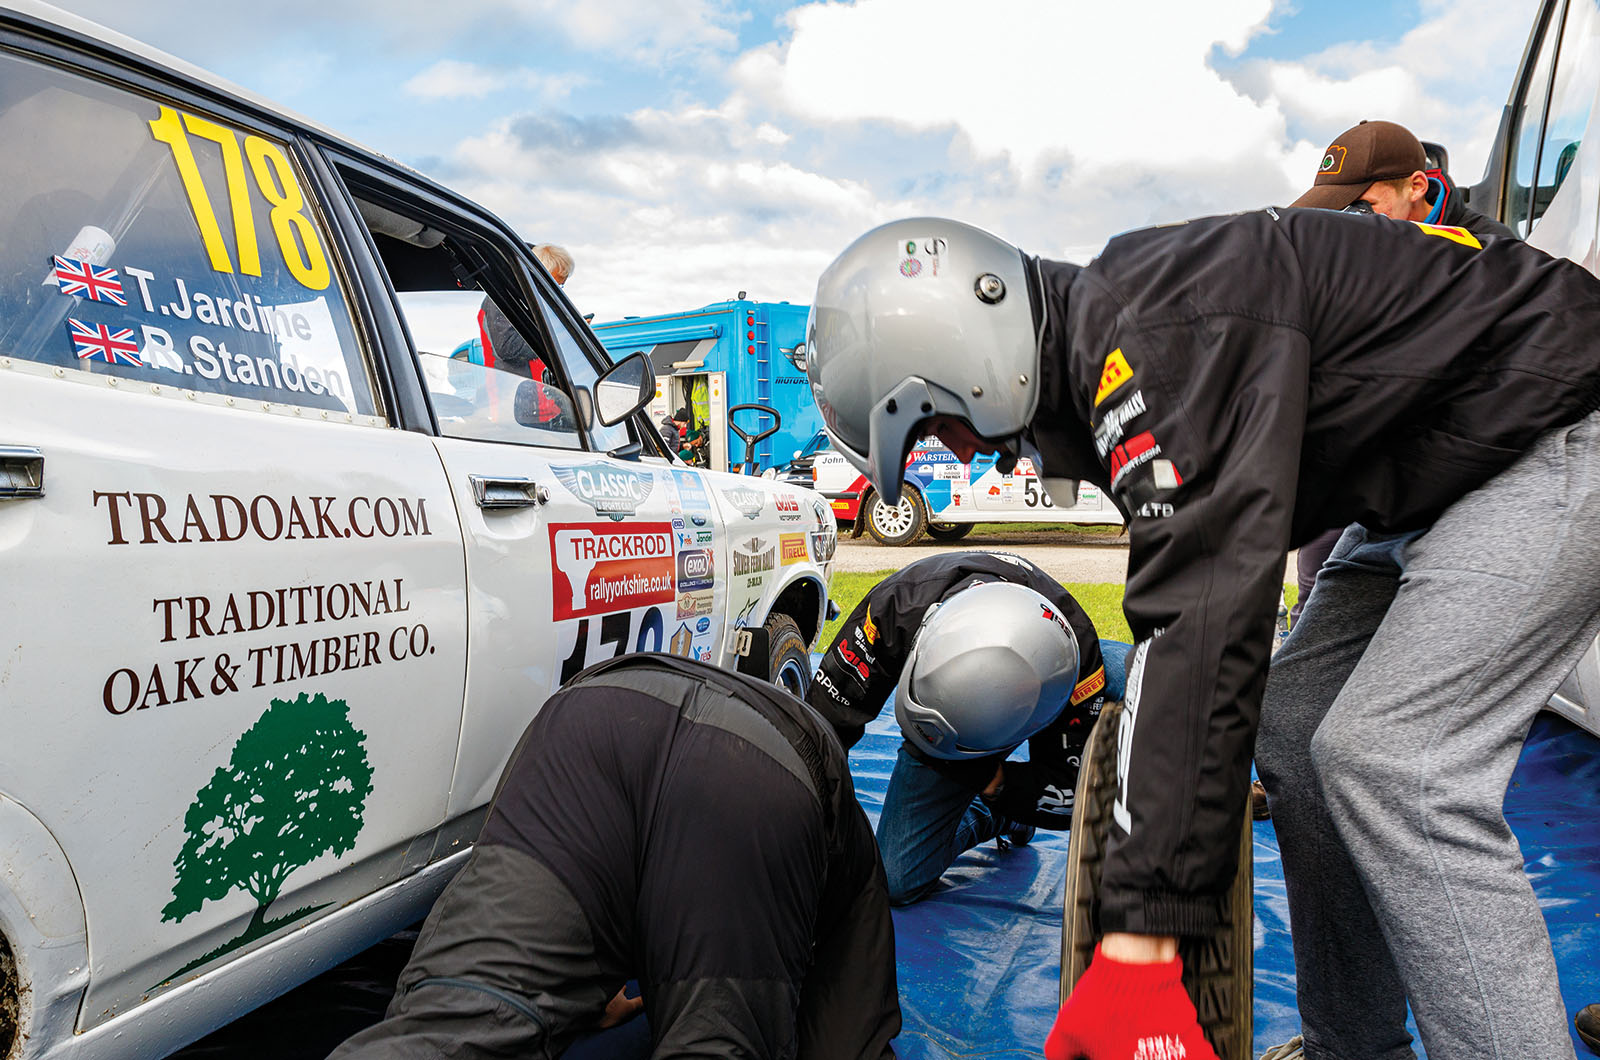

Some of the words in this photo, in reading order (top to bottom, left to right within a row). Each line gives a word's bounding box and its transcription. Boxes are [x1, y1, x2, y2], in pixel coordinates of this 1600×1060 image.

[148, 104, 331, 290] 178
[124, 265, 312, 341] T.Jardine
[140, 324, 344, 398] R.Standen
[577, 469, 642, 500] CLASSIC
[92, 490, 433, 545] TRADOAK.COM
[570, 535, 666, 560] TRACKROD
[782, 538, 806, 560] PIRELLI
[153, 578, 411, 643] TRADITIONAL
[590, 570, 672, 603] rallyyorkshire.co.uk
[102, 656, 207, 716] OAK
[209, 652, 241, 696] &
[247, 630, 382, 689] TIMBER
[388, 623, 436, 662] CO.
